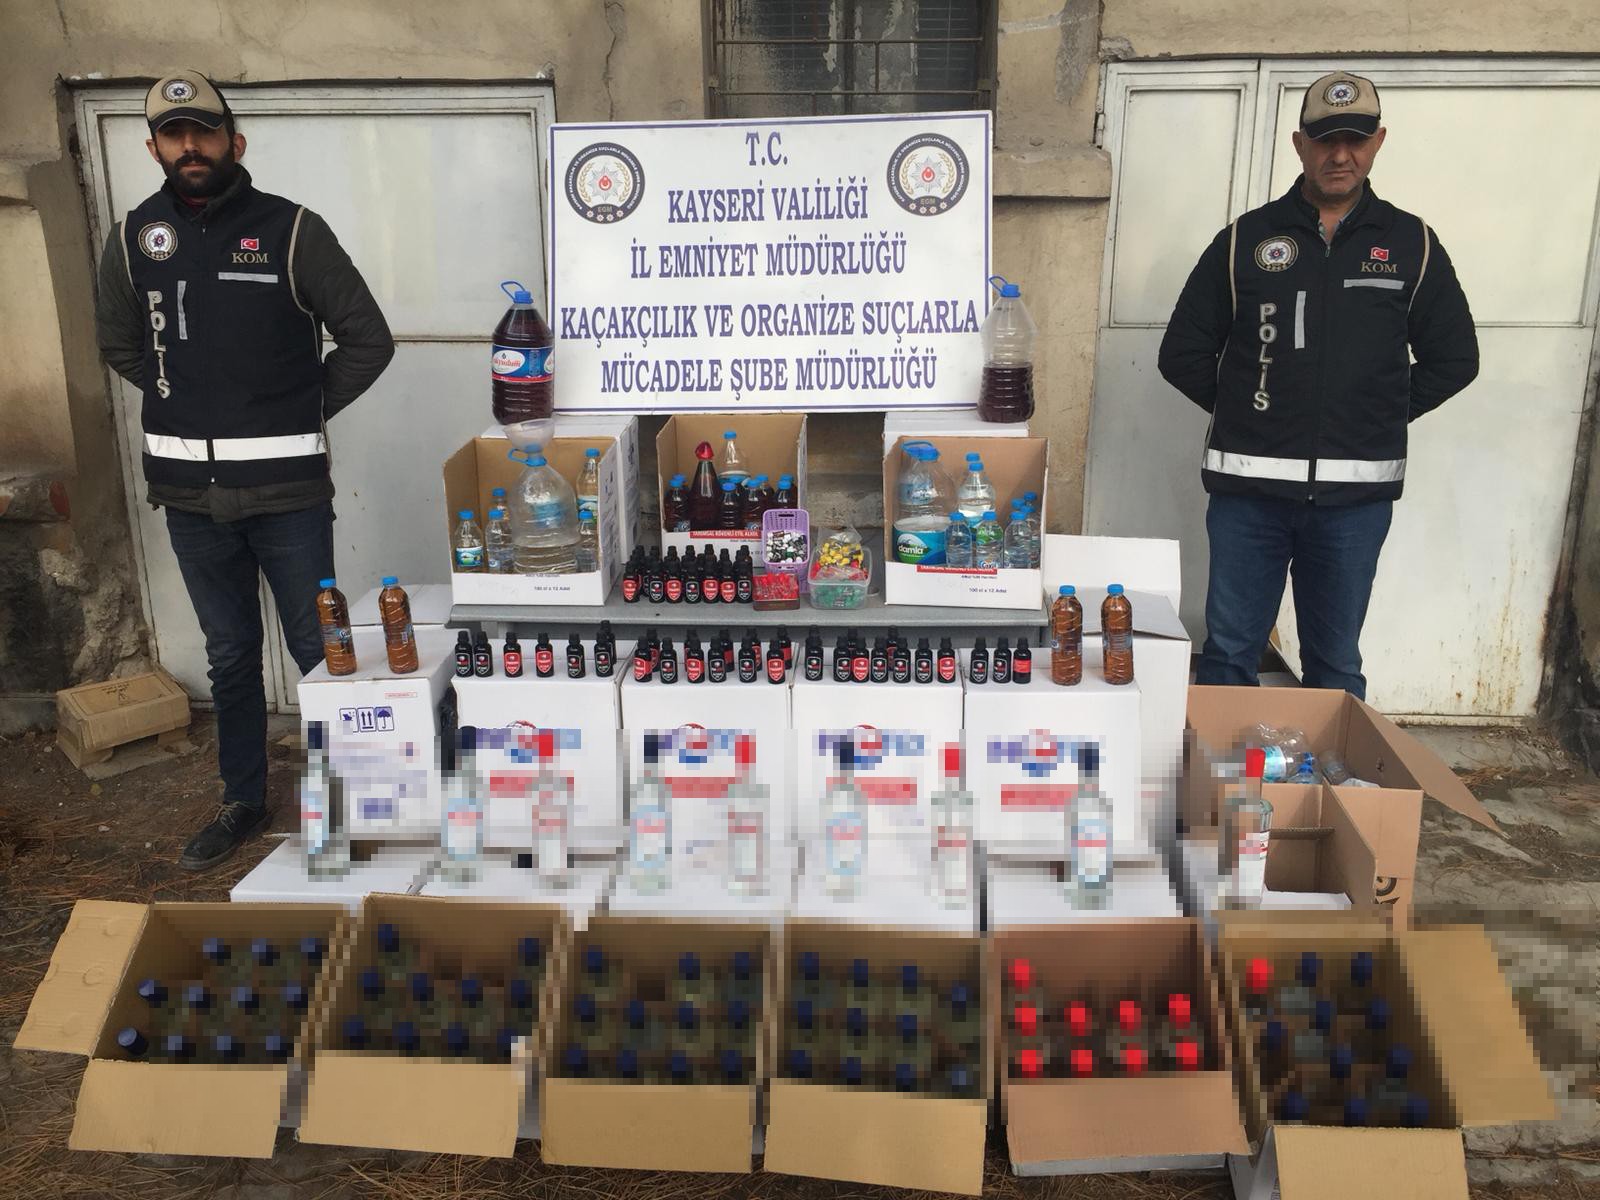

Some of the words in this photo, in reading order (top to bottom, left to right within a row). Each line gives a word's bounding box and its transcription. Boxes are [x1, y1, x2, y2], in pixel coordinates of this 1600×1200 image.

[746, 131, 788, 166] T.C.
[668, 181, 765, 223] KAYSERİ
[773, 175, 868, 221] VALİLİĞİ
[231, 252, 269, 265] KOM
[630, 237, 652, 279] İL
[659, 236, 759, 278] EMNİYET
[766, 231, 907, 276] MÜDÜRLÜĞÜ
[1360, 261, 1398, 274] KOM
[560, 306, 698, 348] KAÇAKÇILIK
[704, 304, 734, 337] VE
[741, 294, 855, 337] ORGANİZE
[862, 299, 980, 343] SUÇLARLA
[601, 352, 723, 393] MÜCADELE
[730, 357, 788, 401] ŞUBE
[795, 346, 938, 391] MÜDÜRLÜĞÜ
[898, 545, 924, 555] damla
